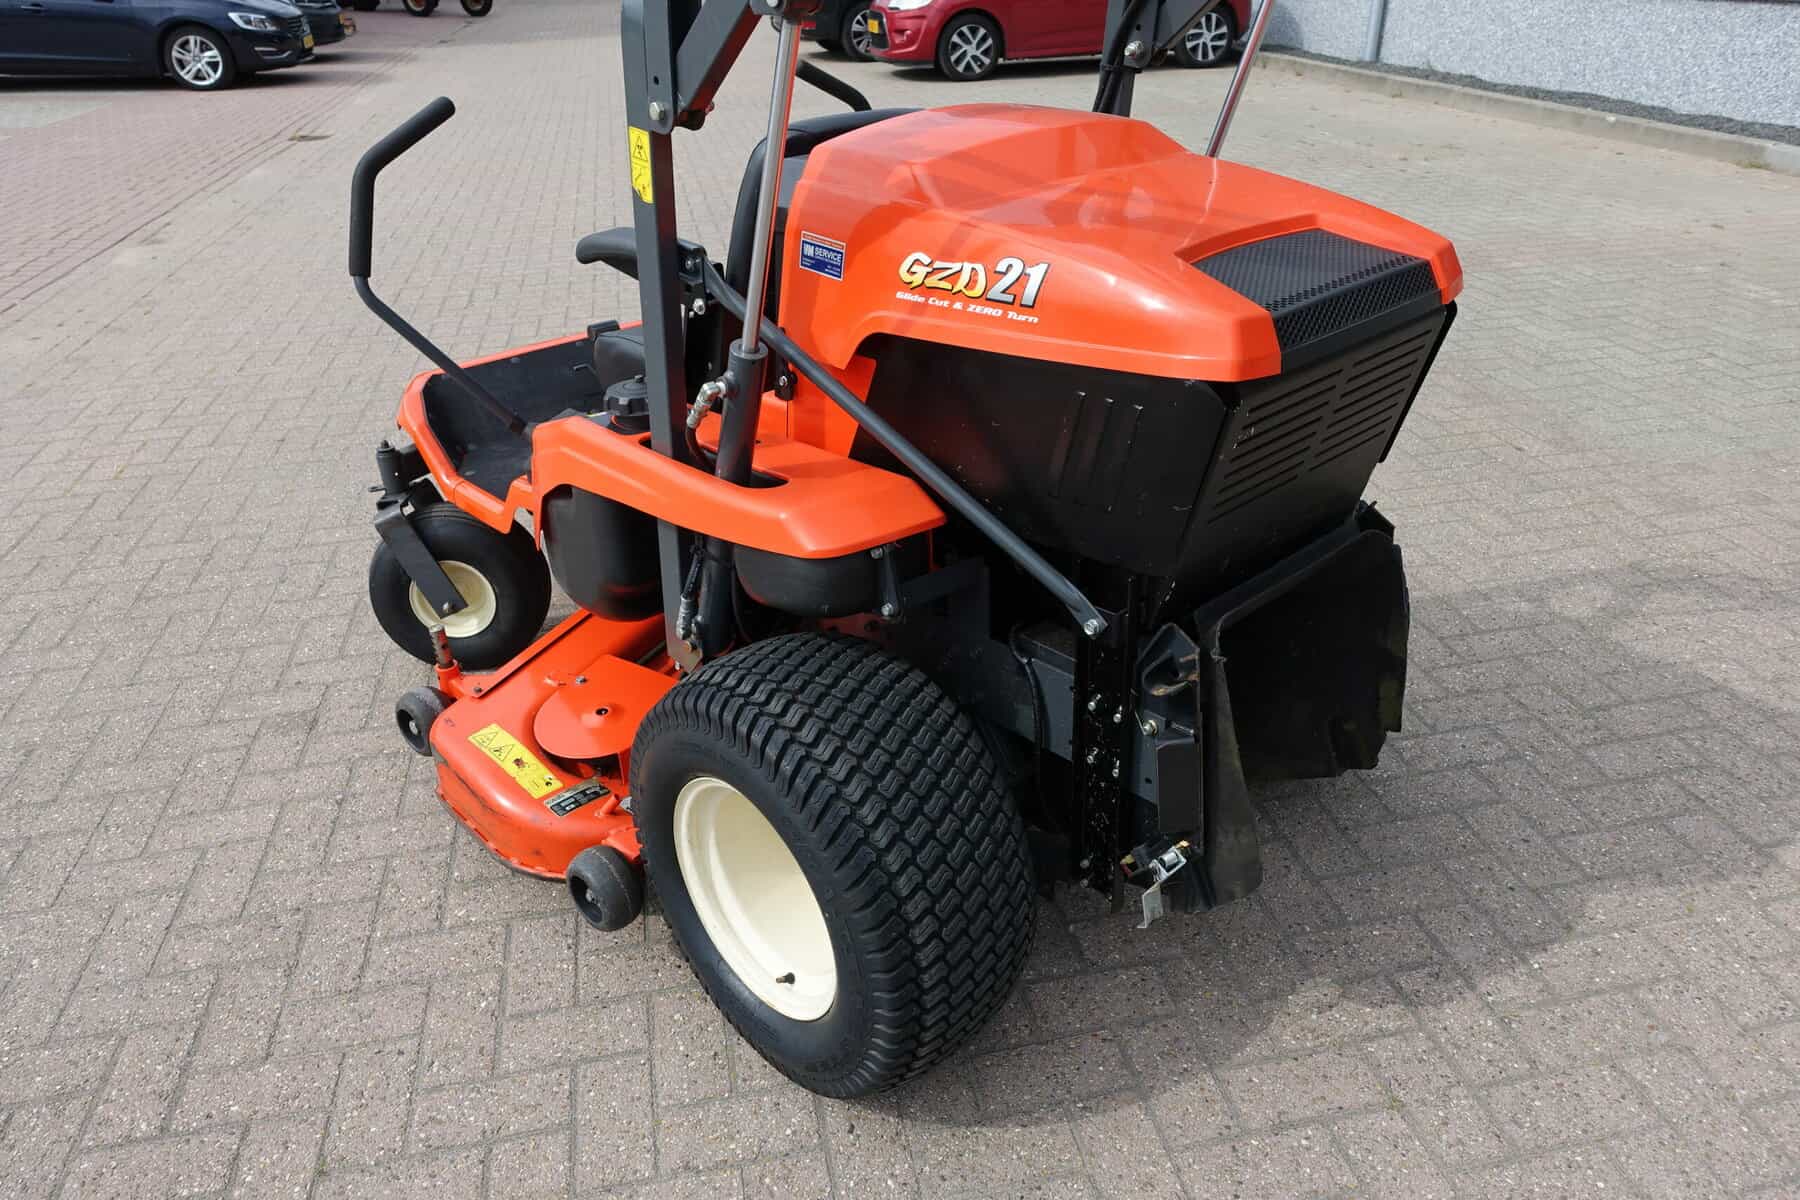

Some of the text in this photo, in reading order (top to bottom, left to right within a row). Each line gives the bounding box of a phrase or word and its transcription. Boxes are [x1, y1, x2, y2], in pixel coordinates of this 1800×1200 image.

[815, 246, 842, 264] SERVICE
[896, 290, 1039, 324] Glide Cut & ZERO Turn
